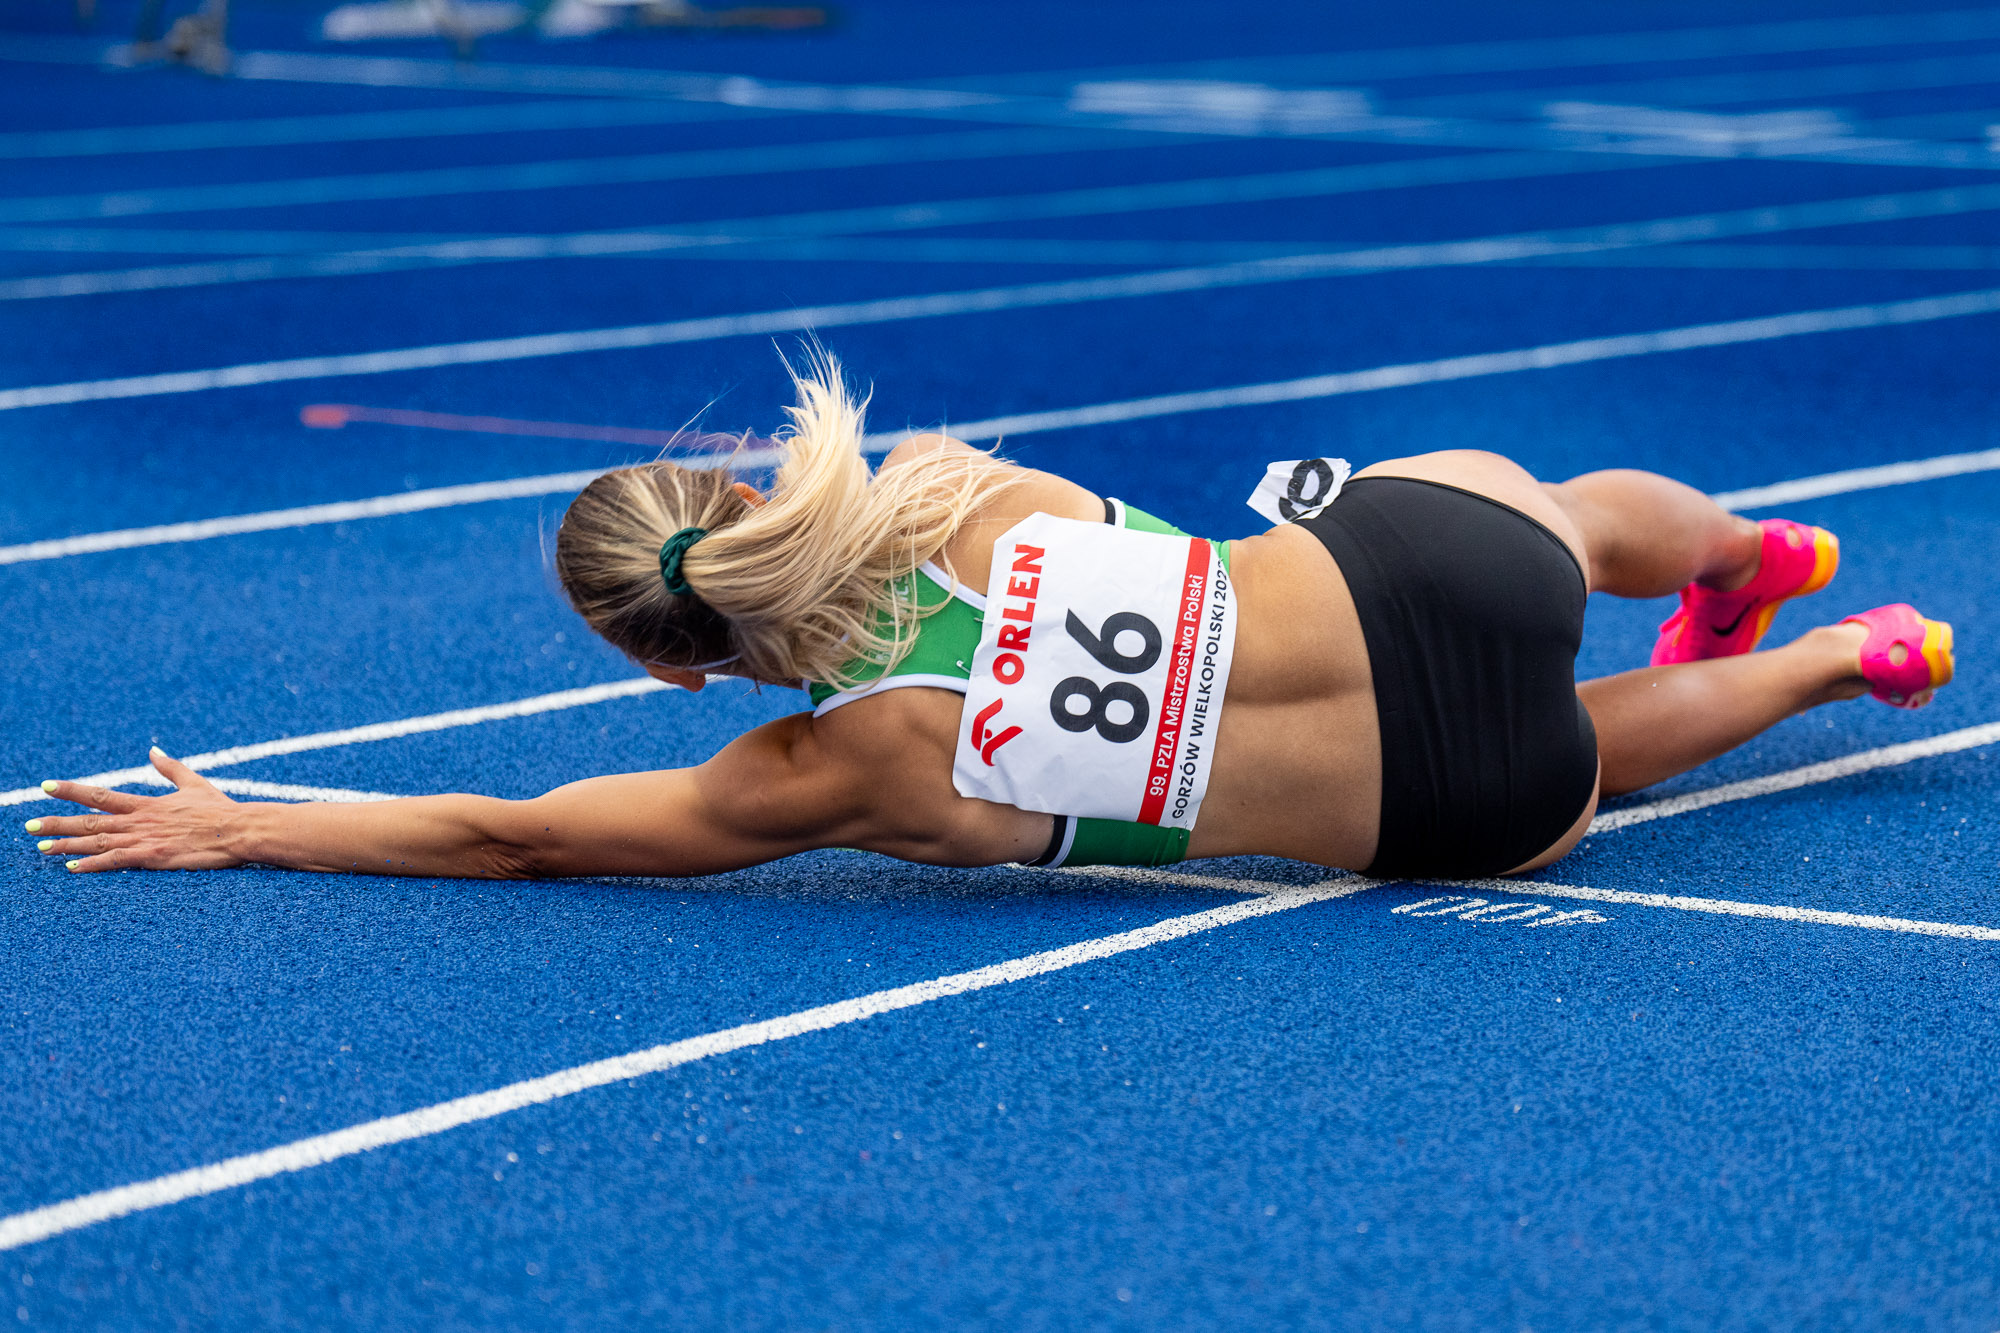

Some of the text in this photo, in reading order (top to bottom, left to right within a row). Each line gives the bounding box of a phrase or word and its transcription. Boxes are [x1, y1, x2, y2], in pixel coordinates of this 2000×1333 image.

[992, 543, 1046, 685] ORLEN
[1050, 608, 1163, 744] 86
[1149, 574, 1204, 797] 99. PZLA Mistrzostwa Polski
[1172, 742, 1201, 819] GORZÓW
[1189, 603, 1226, 737] WIELKOPOLSKI
